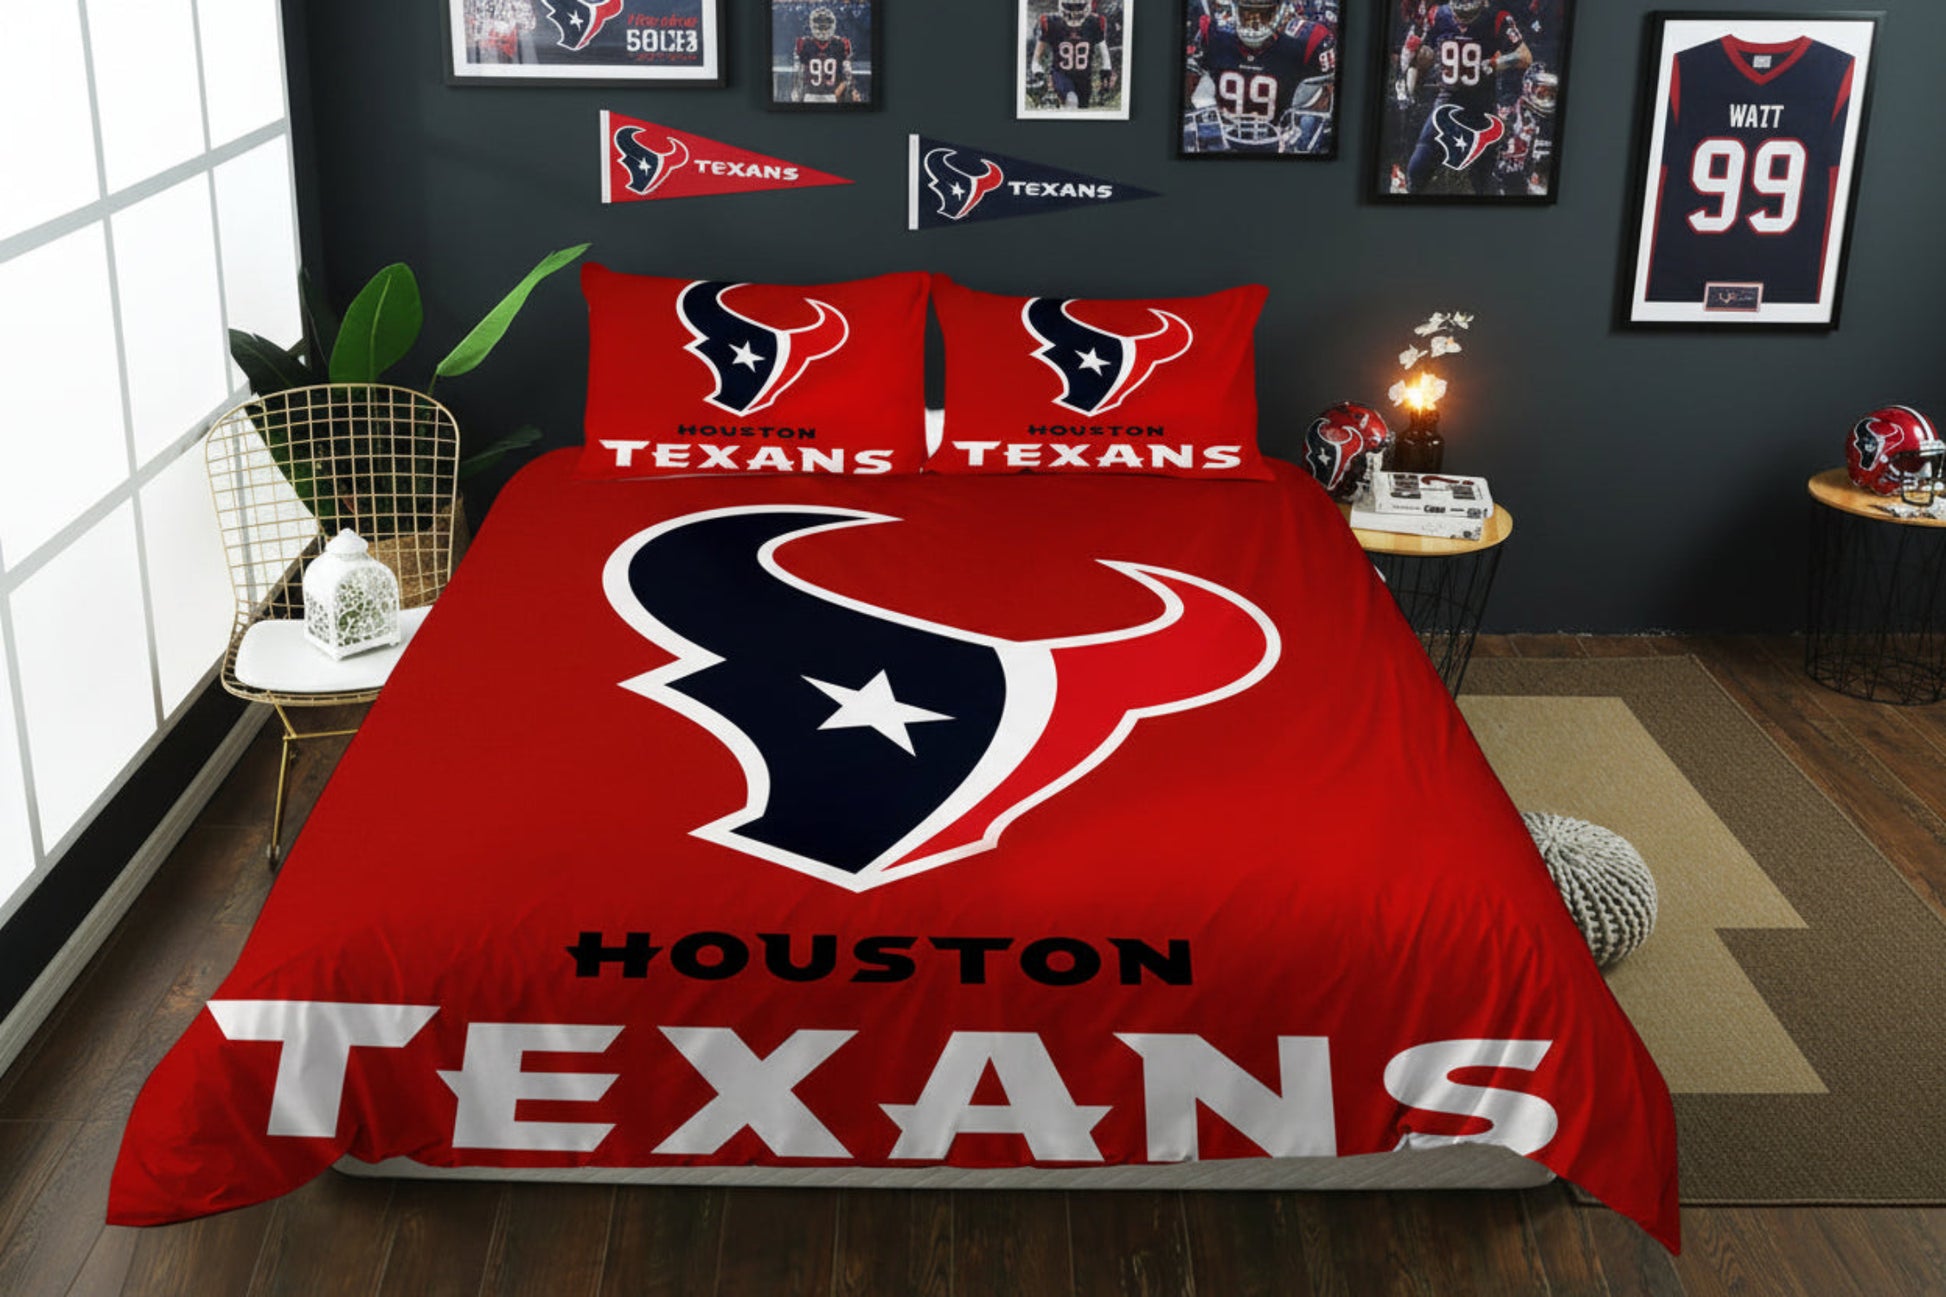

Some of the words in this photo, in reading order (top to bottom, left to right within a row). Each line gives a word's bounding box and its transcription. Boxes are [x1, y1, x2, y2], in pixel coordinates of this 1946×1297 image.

[809, 58, 837, 86] 99
[1441, 41, 1481, 86] 99
[1218, 70, 1278, 123] 99
[694, 159, 799, 181] TEXANS
[1687, 137, 1808, 235] 99
[1008, 181, 1113, 199] TEXANS
[677, 424, 817, 439] HOUSTON
[1028, 424, 1165, 437] HOUSTON
[599, 439, 894, 475] TEXANS
[952, 441, 1242, 469] TEXANS
[566, 931, 1193, 986] HOUSTON
[205, 1000, 1559, 1162] TEXANS
